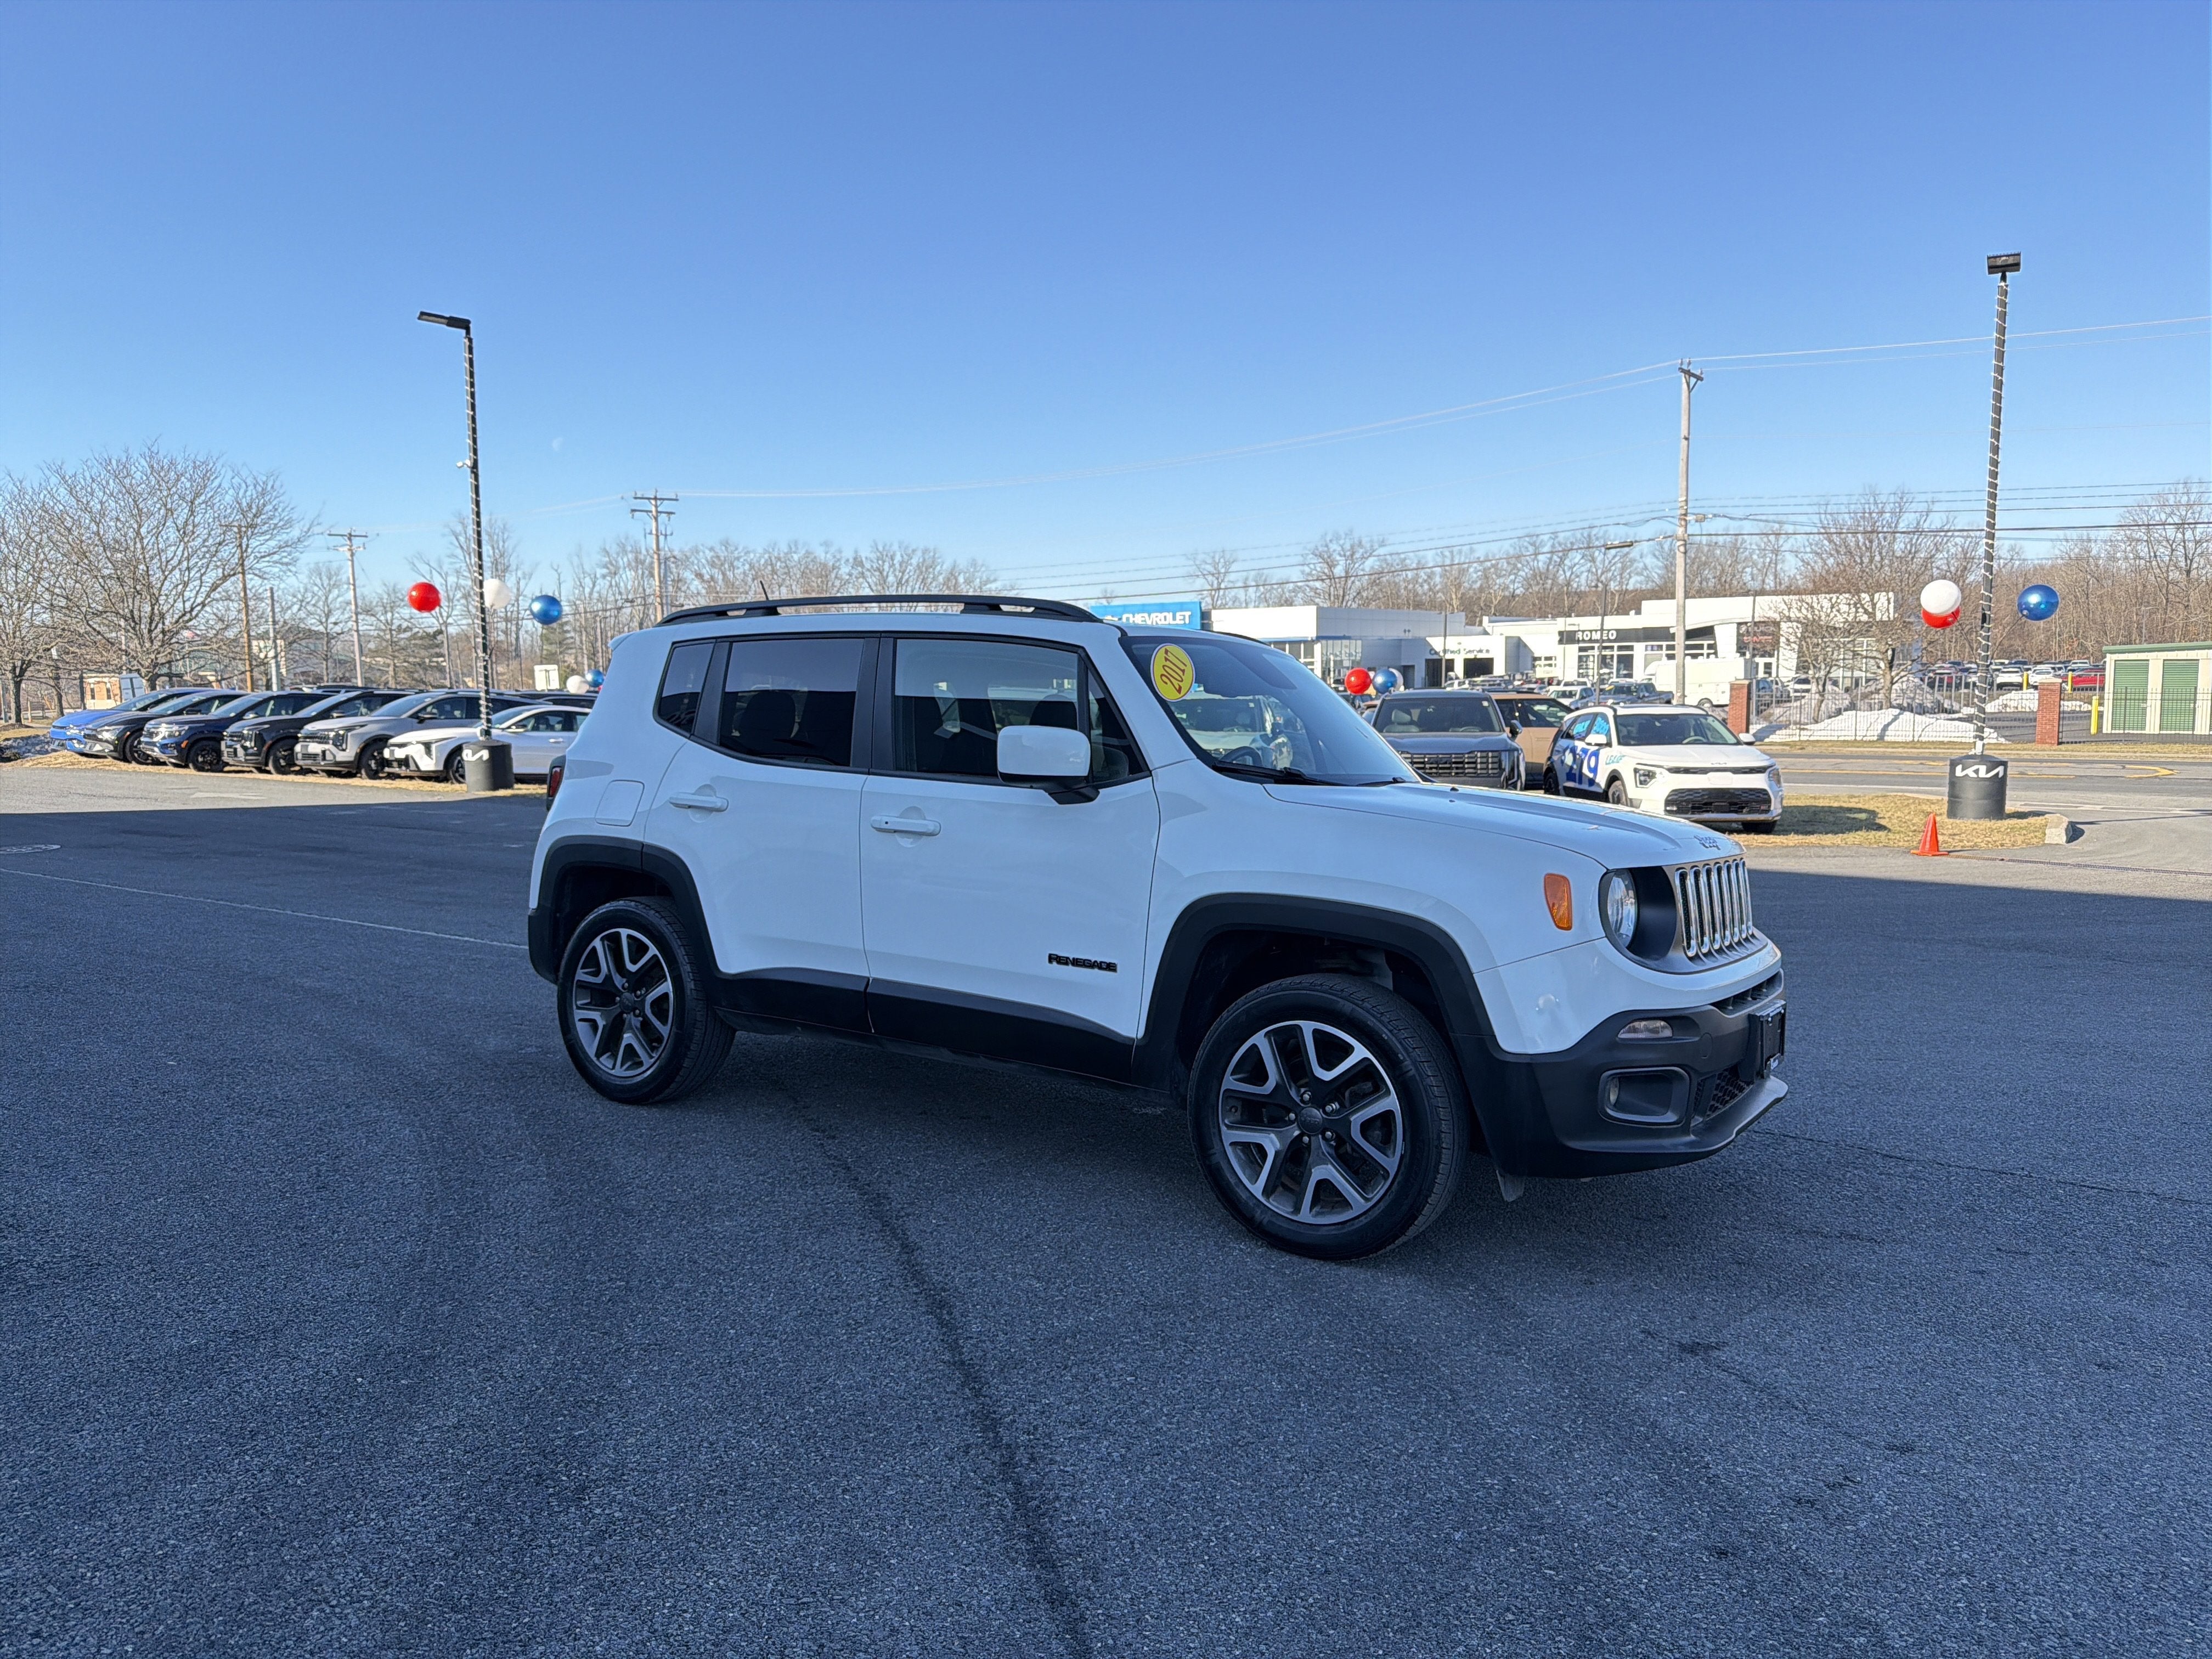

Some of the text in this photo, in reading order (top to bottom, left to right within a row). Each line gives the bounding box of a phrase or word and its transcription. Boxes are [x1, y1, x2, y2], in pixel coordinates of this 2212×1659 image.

[1122, 611, 1192, 625] CHEVROLET
[1576, 630, 1617, 640] ROMEO
[1160, 648, 1187, 695] 2017
[1955, 764, 2004, 778] KIA
[1048, 953, 1118, 973] RENEGADE
